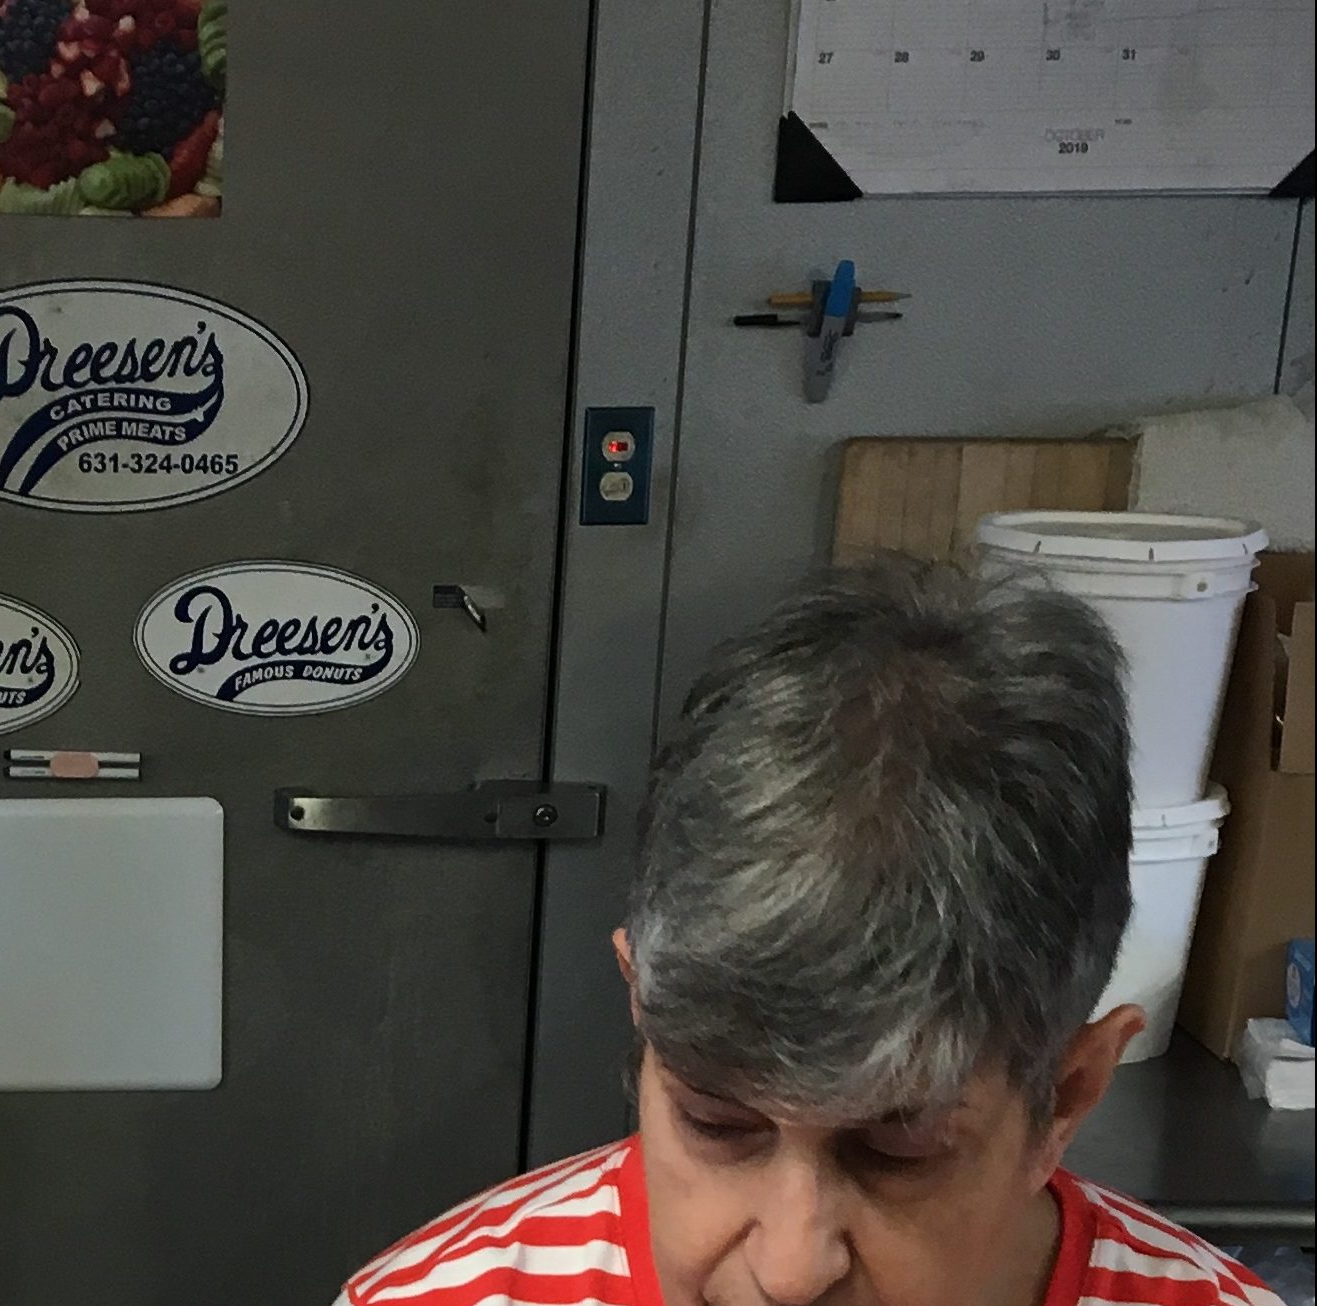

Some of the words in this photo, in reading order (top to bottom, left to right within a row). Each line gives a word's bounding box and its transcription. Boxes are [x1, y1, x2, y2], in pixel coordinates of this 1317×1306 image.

[818, 52, 833, 64] 27
[894, 51, 910, 63] 28
[970, 50, 985, 62] 29
[1046, 49, 1061, 61] 30
[1122, 48, 1137, 60] 31
[1058, 142, 1089, 154] 2019
[49, 391, 172, 421] CATERING
[57, 420, 117, 452] PRIME
[121, 420, 187, 442] MEATS
[77, 452, 239, 475] 631-324-0465
[169, 585, 394, 676] Dreesen's
[235, 665, 295, 691] FAMOUS
[302, 665, 363, 681] DONUTS
